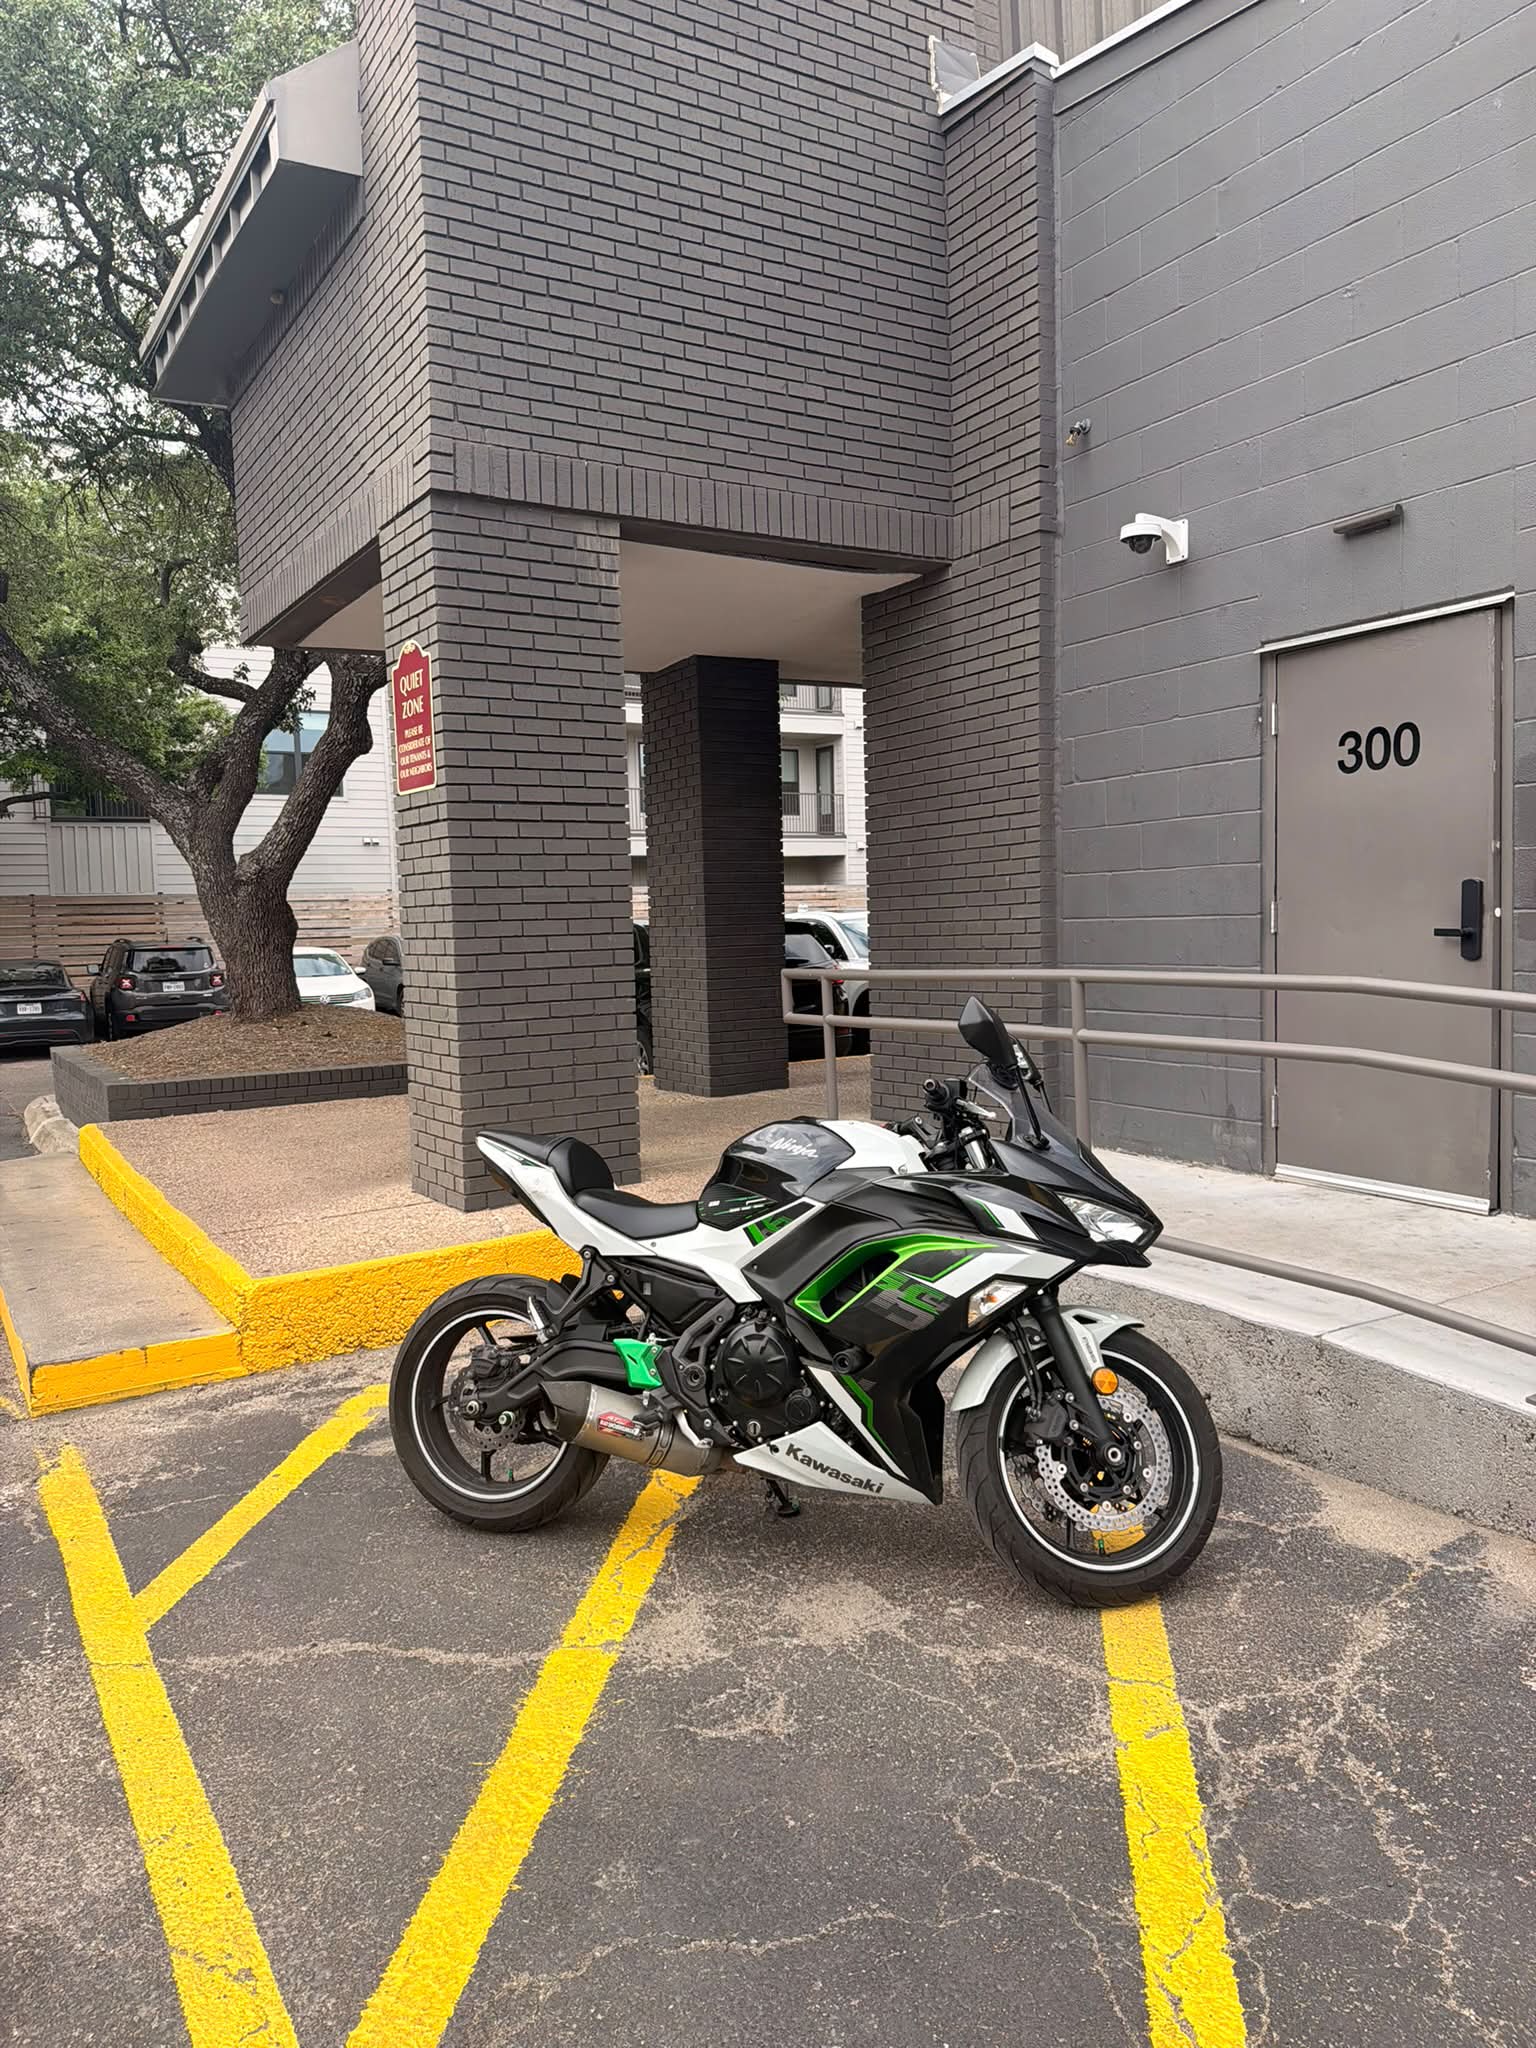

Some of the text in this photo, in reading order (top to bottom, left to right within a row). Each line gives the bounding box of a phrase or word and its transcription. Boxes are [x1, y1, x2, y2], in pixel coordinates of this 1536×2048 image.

[400, 669, 424, 696] QUIET
[402, 696, 424, 719] ZONE
[1337, 721, 1421, 775] 300
[769, 1136, 819, 1159] Ninja
[785, 1442, 885, 1494] Kawasaki
